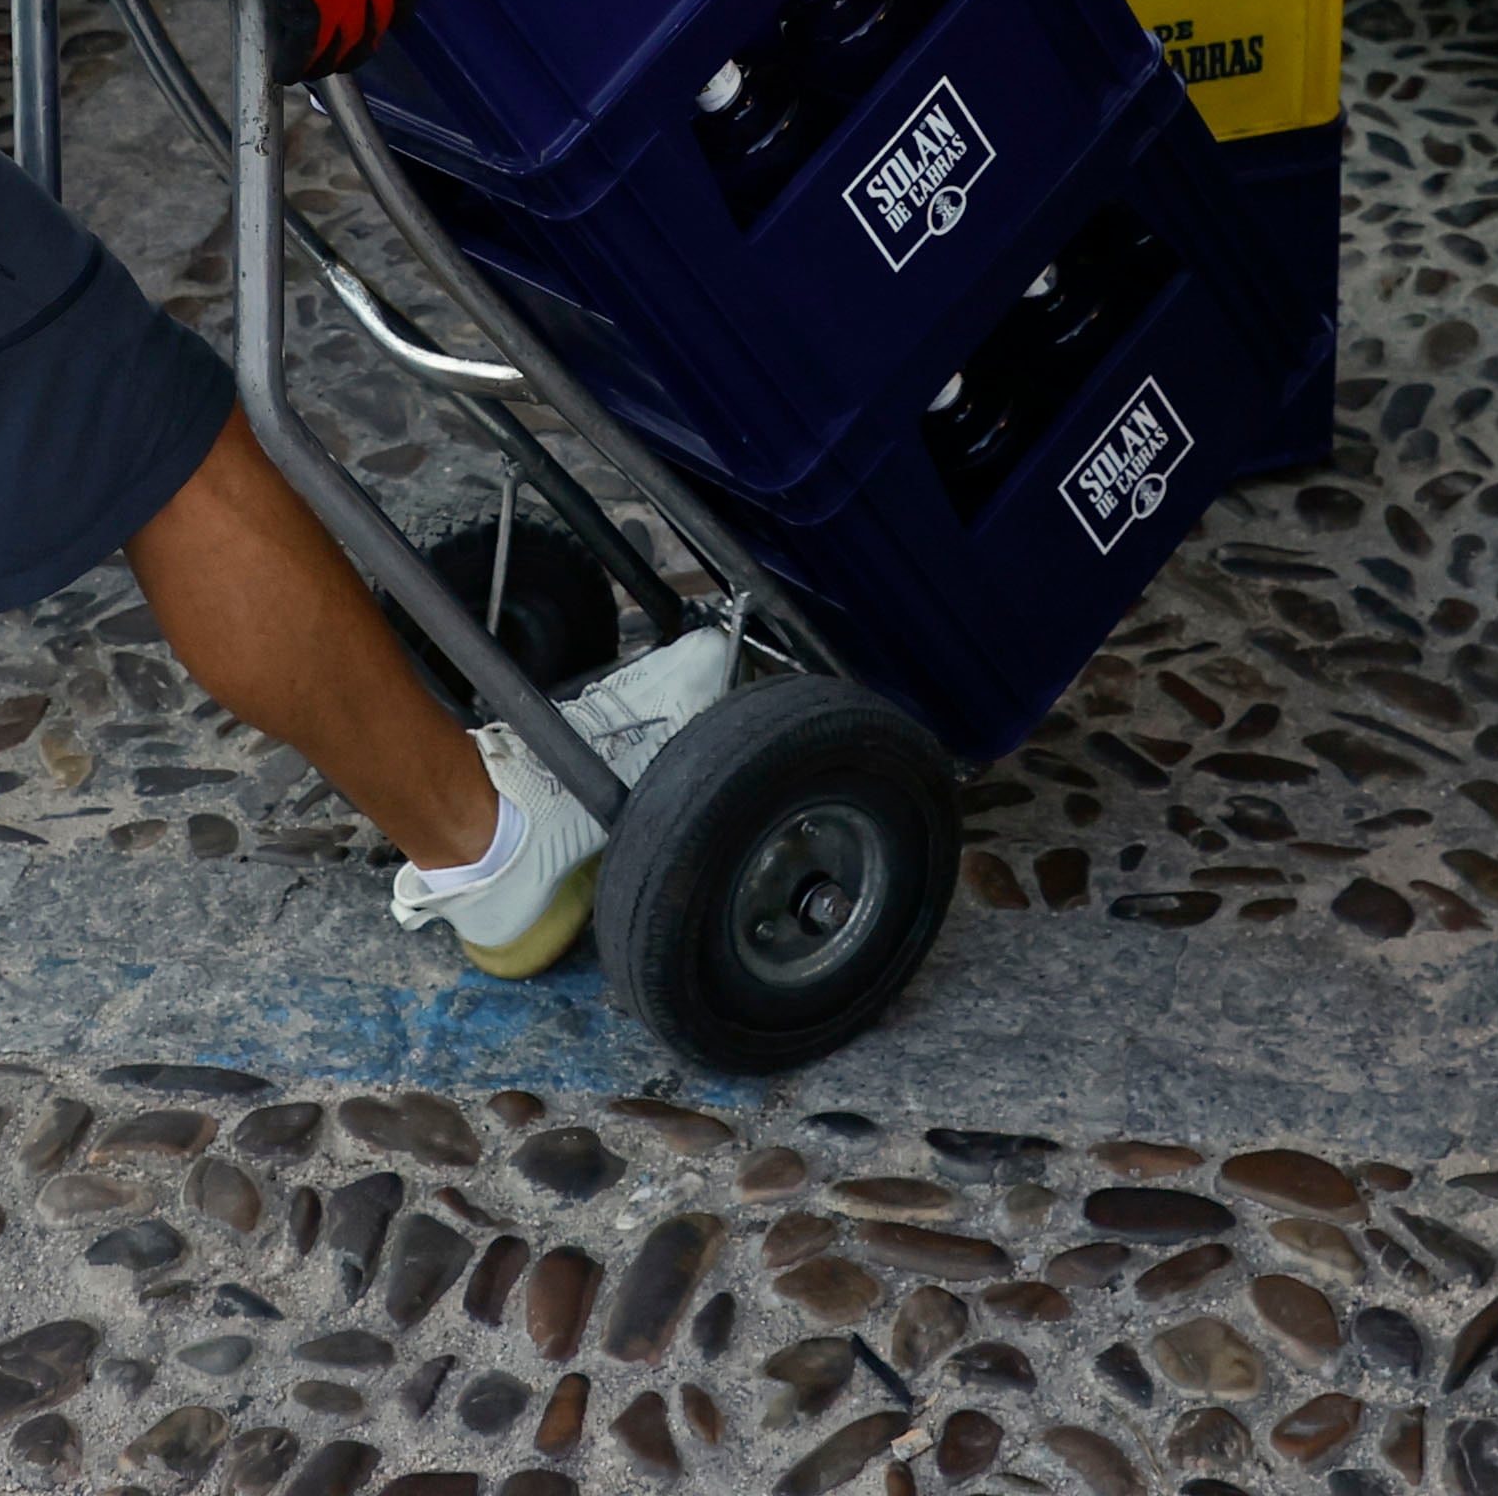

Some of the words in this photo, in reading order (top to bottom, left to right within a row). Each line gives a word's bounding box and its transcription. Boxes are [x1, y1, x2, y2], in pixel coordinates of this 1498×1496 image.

[1168, 35, 1264, 84] ABRAS
[866, 103, 955, 215] SOLAN
[885, 200, 913, 234] DE
[908, 133, 968, 208] CABRAS
[1078, 399, 1160, 503] SOLAN
[1094, 489, 1119, 520] DE
[1115, 426, 1169, 495] CABRAS
